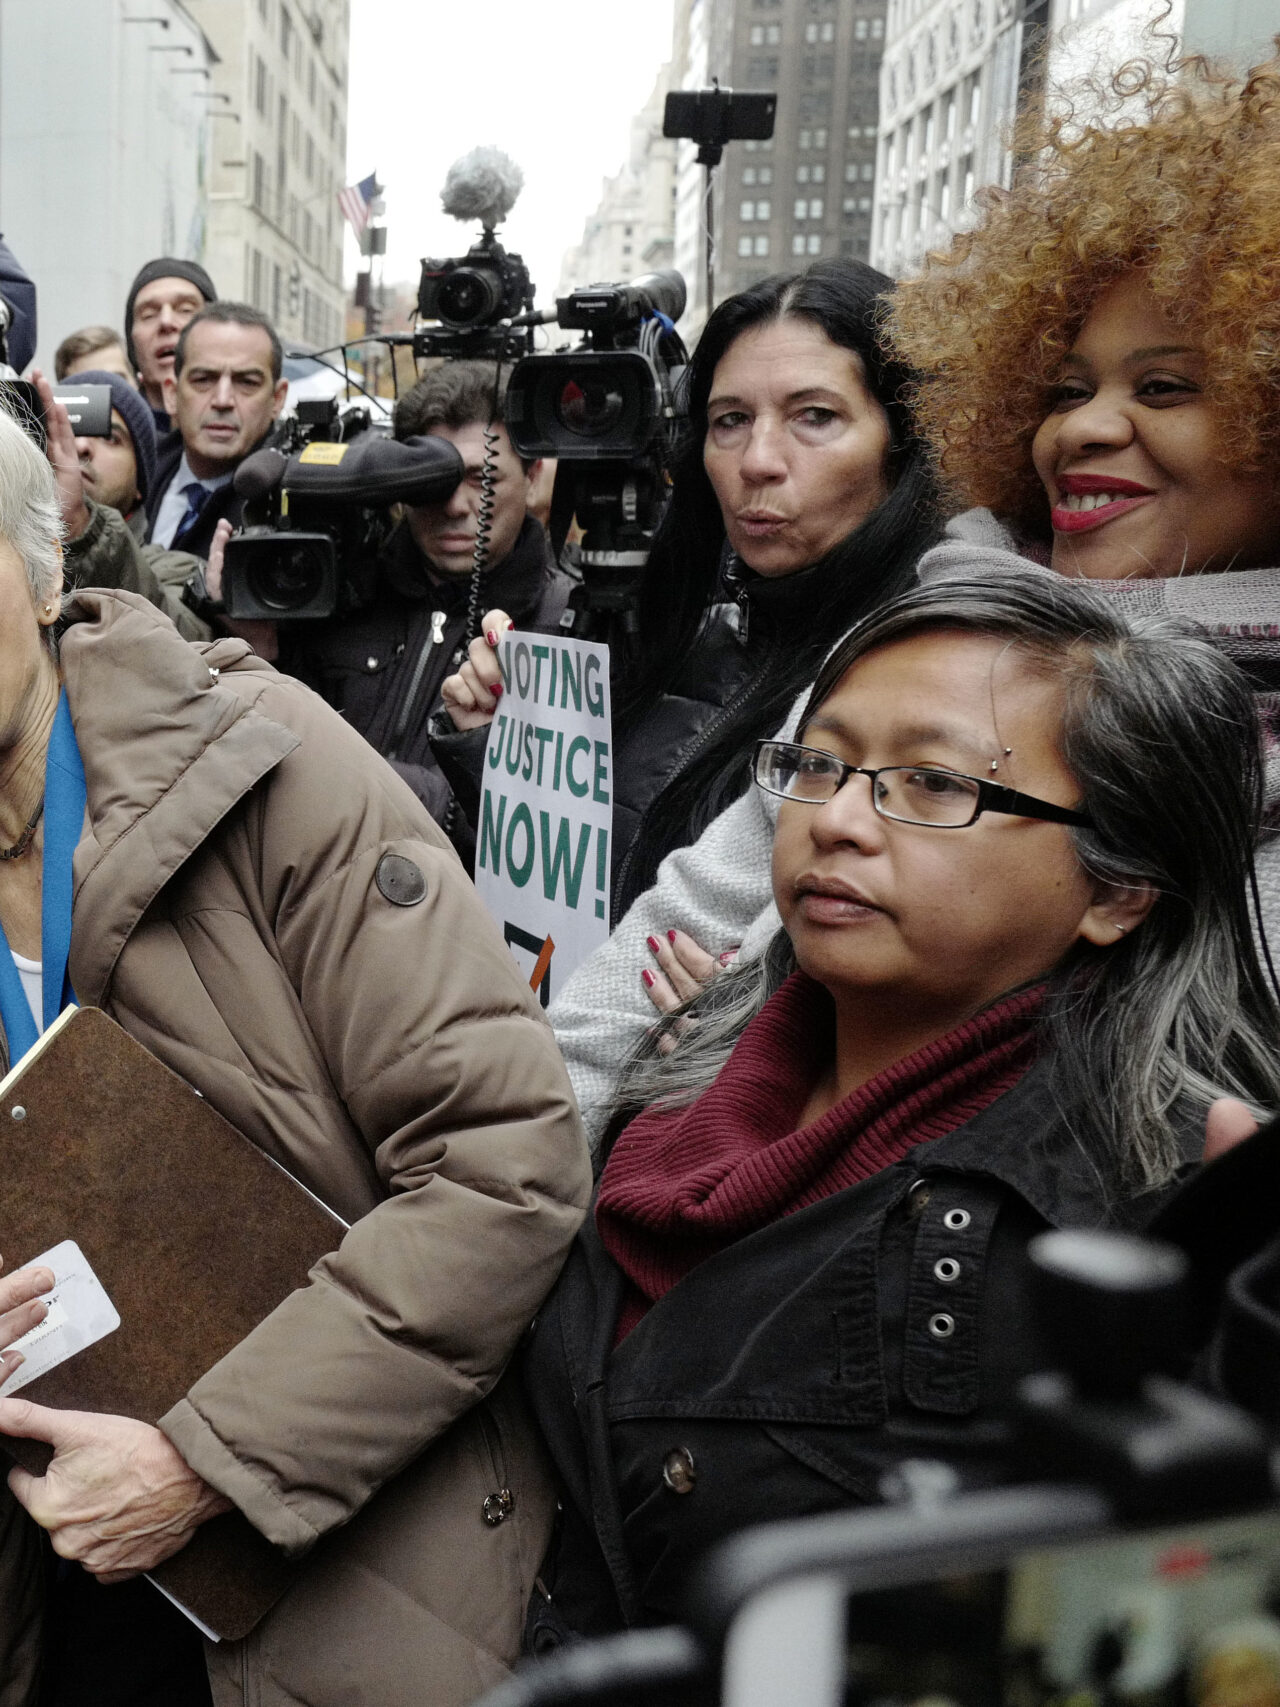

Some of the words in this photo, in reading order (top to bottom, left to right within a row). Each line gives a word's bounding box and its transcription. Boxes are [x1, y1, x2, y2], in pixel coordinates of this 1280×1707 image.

[496, 641, 605, 718] VOTING
[488, 715, 611, 806] JUSTICE
[478, 788, 609, 921] NOW!
